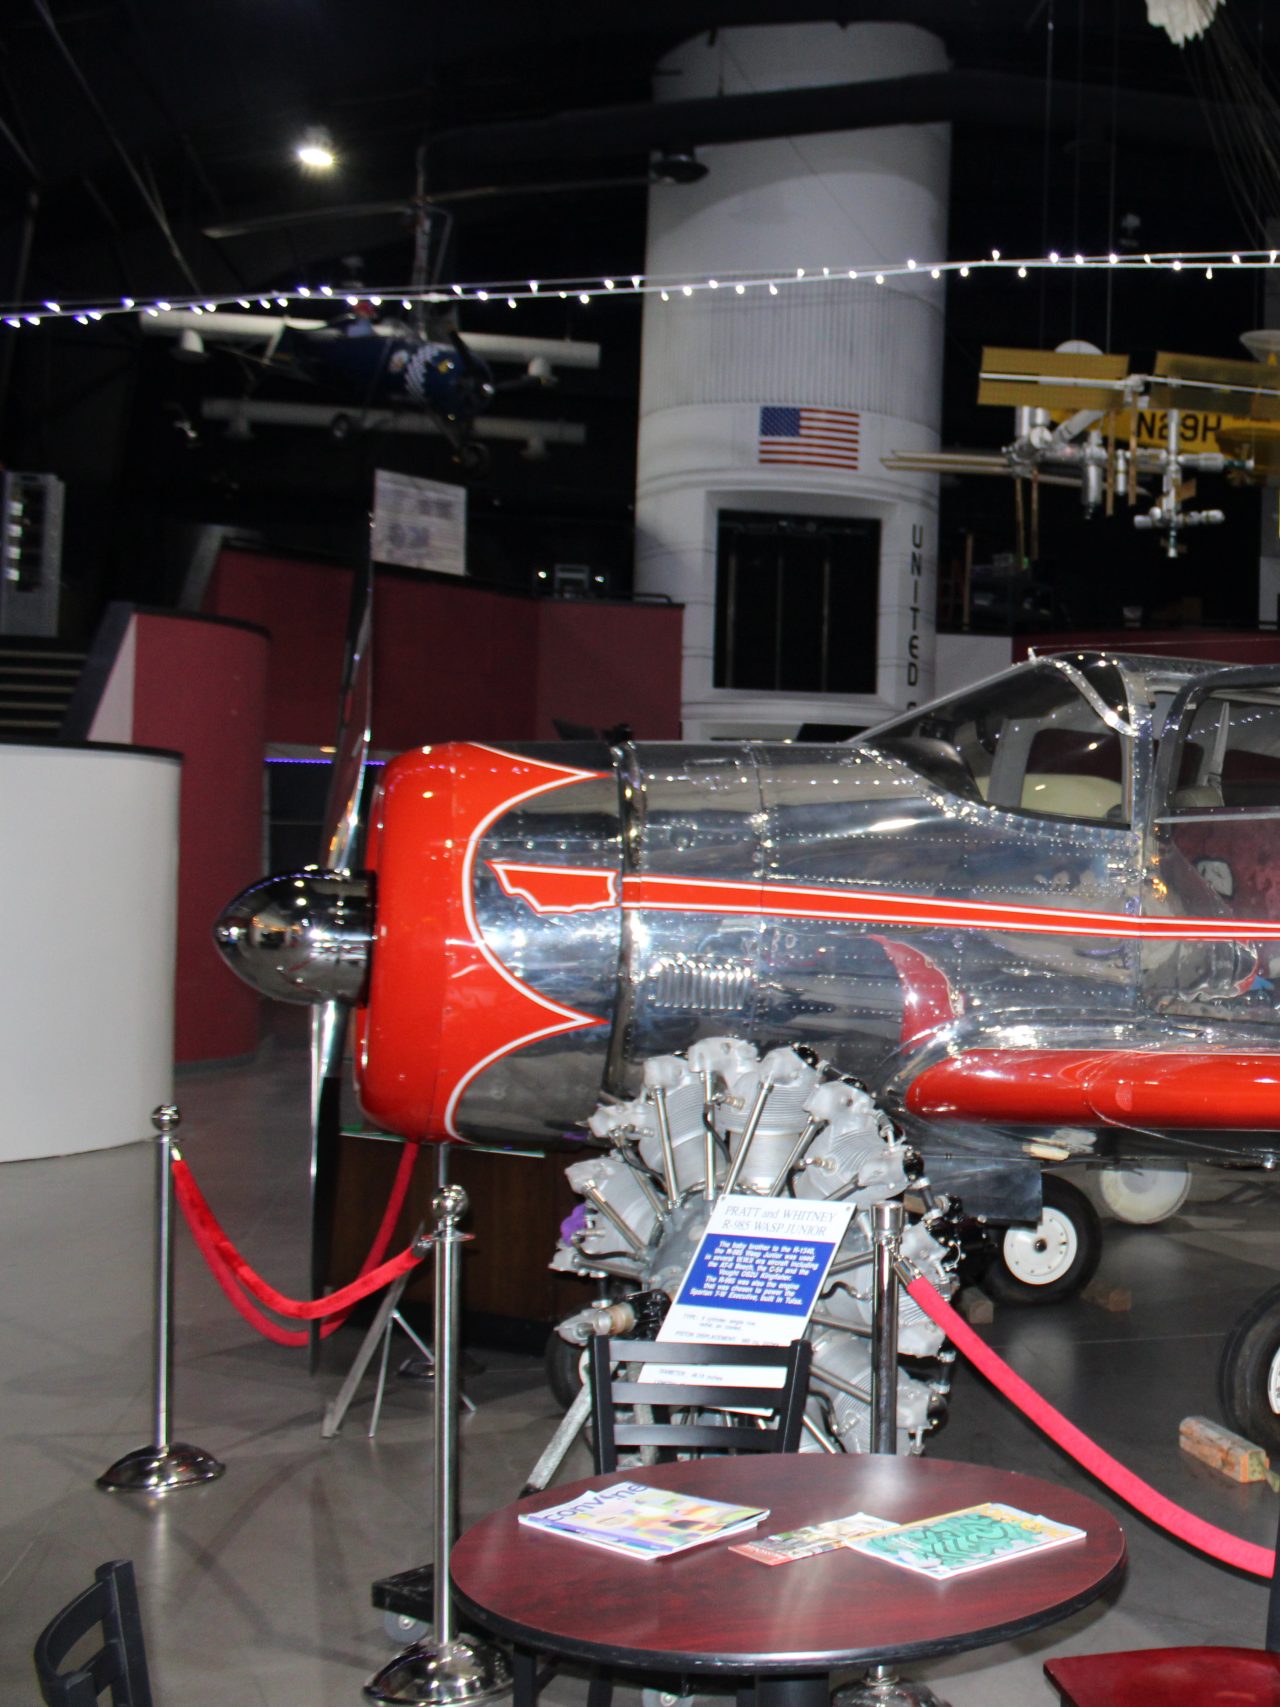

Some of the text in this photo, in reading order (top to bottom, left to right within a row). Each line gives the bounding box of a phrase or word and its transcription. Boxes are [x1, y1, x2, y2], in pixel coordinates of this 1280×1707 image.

[907, 524, 923, 687] UNITED
[724, 1205, 837, 1222] PRATT and WHITNEY
[721, 1219, 828, 1236] R-985 WASP JUNIOR
[720, 1240, 731, 1248] The
[707, 1260, 718, 1268] the
[798, 1268, 810, 1276] the
